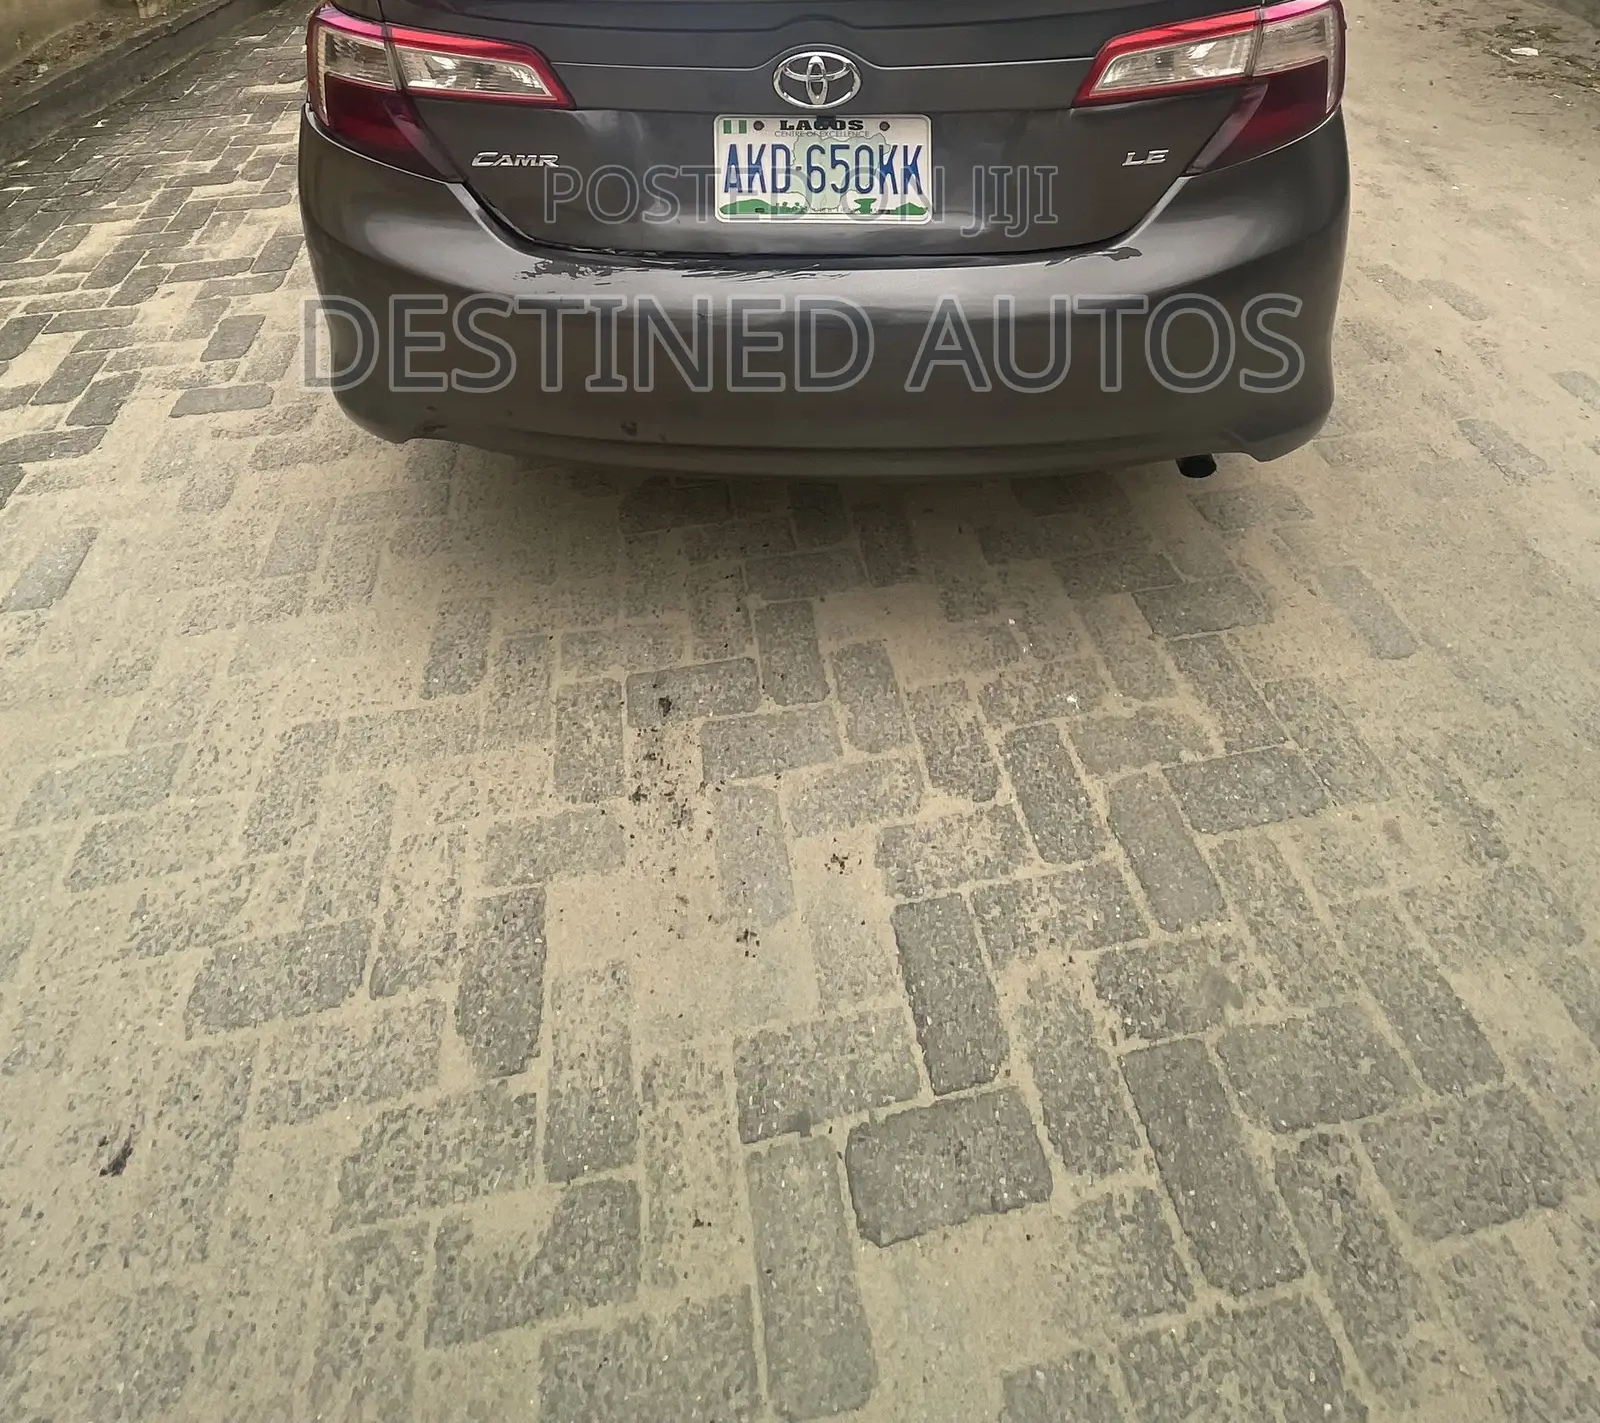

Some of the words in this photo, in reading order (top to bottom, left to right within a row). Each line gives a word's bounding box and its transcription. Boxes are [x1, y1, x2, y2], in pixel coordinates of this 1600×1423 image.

[774, 130, 804, 138] CENTRE
[805, 130, 818, 138] OF
[819, 130, 870, 138] EXCELLENCE
[471, 151, 559, 168] CAMR
[1121, 149, 1169, 166] LE
